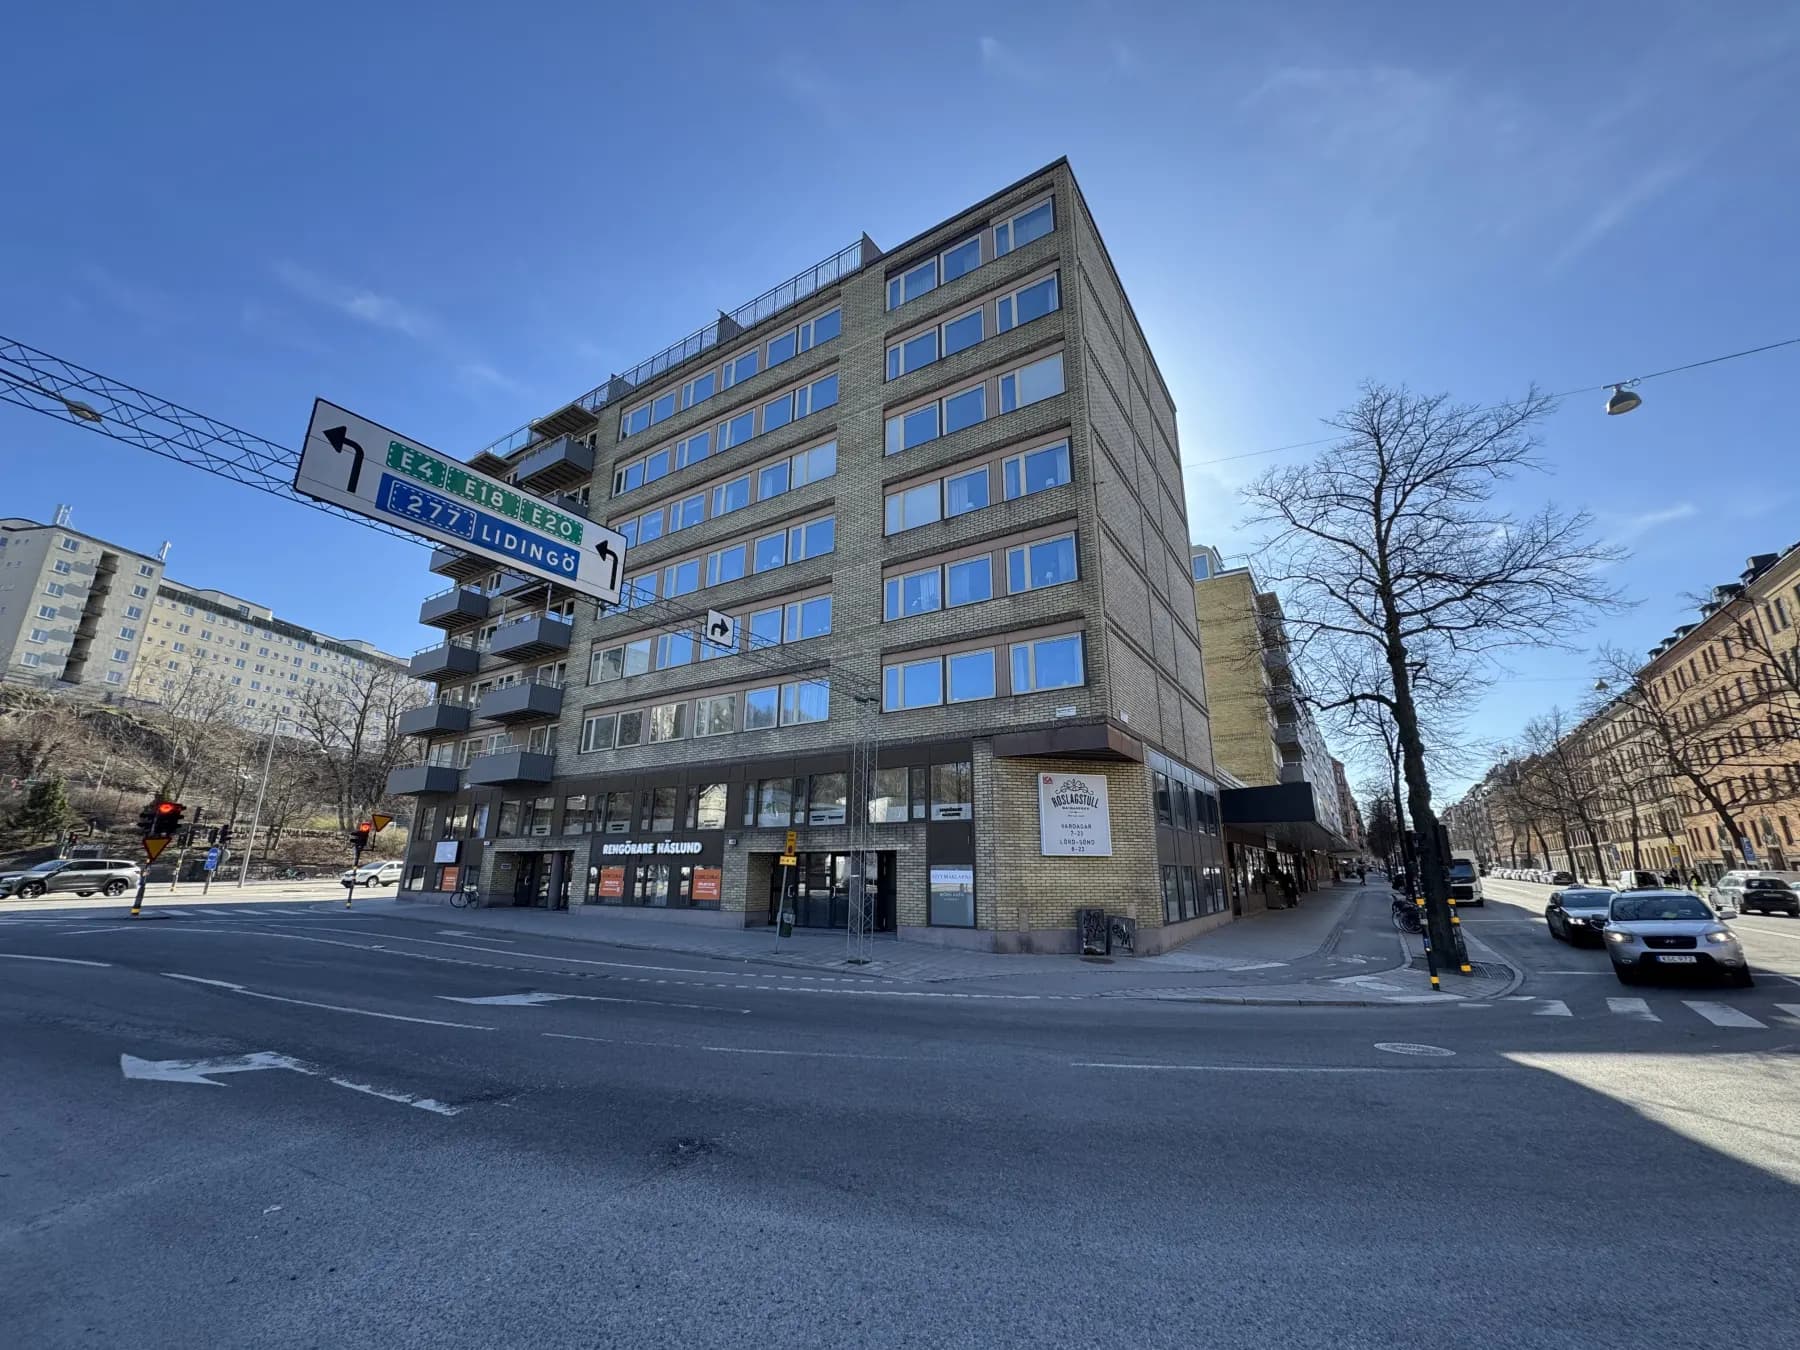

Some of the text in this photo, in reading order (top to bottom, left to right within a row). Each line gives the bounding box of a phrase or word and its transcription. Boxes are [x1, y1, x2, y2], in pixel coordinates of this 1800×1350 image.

[464, 477, 504, 506] E18
[531, 510, 573, 536] E20
[407, 495, 576, 572] 277 LIDINGÖ
[1043, 776, 1053, 784] ICA
[1051, 793, 1099, 808] ROSLAGSTULL
[603, 839, 702, 854] RENGÖRARE NÄSLUND
